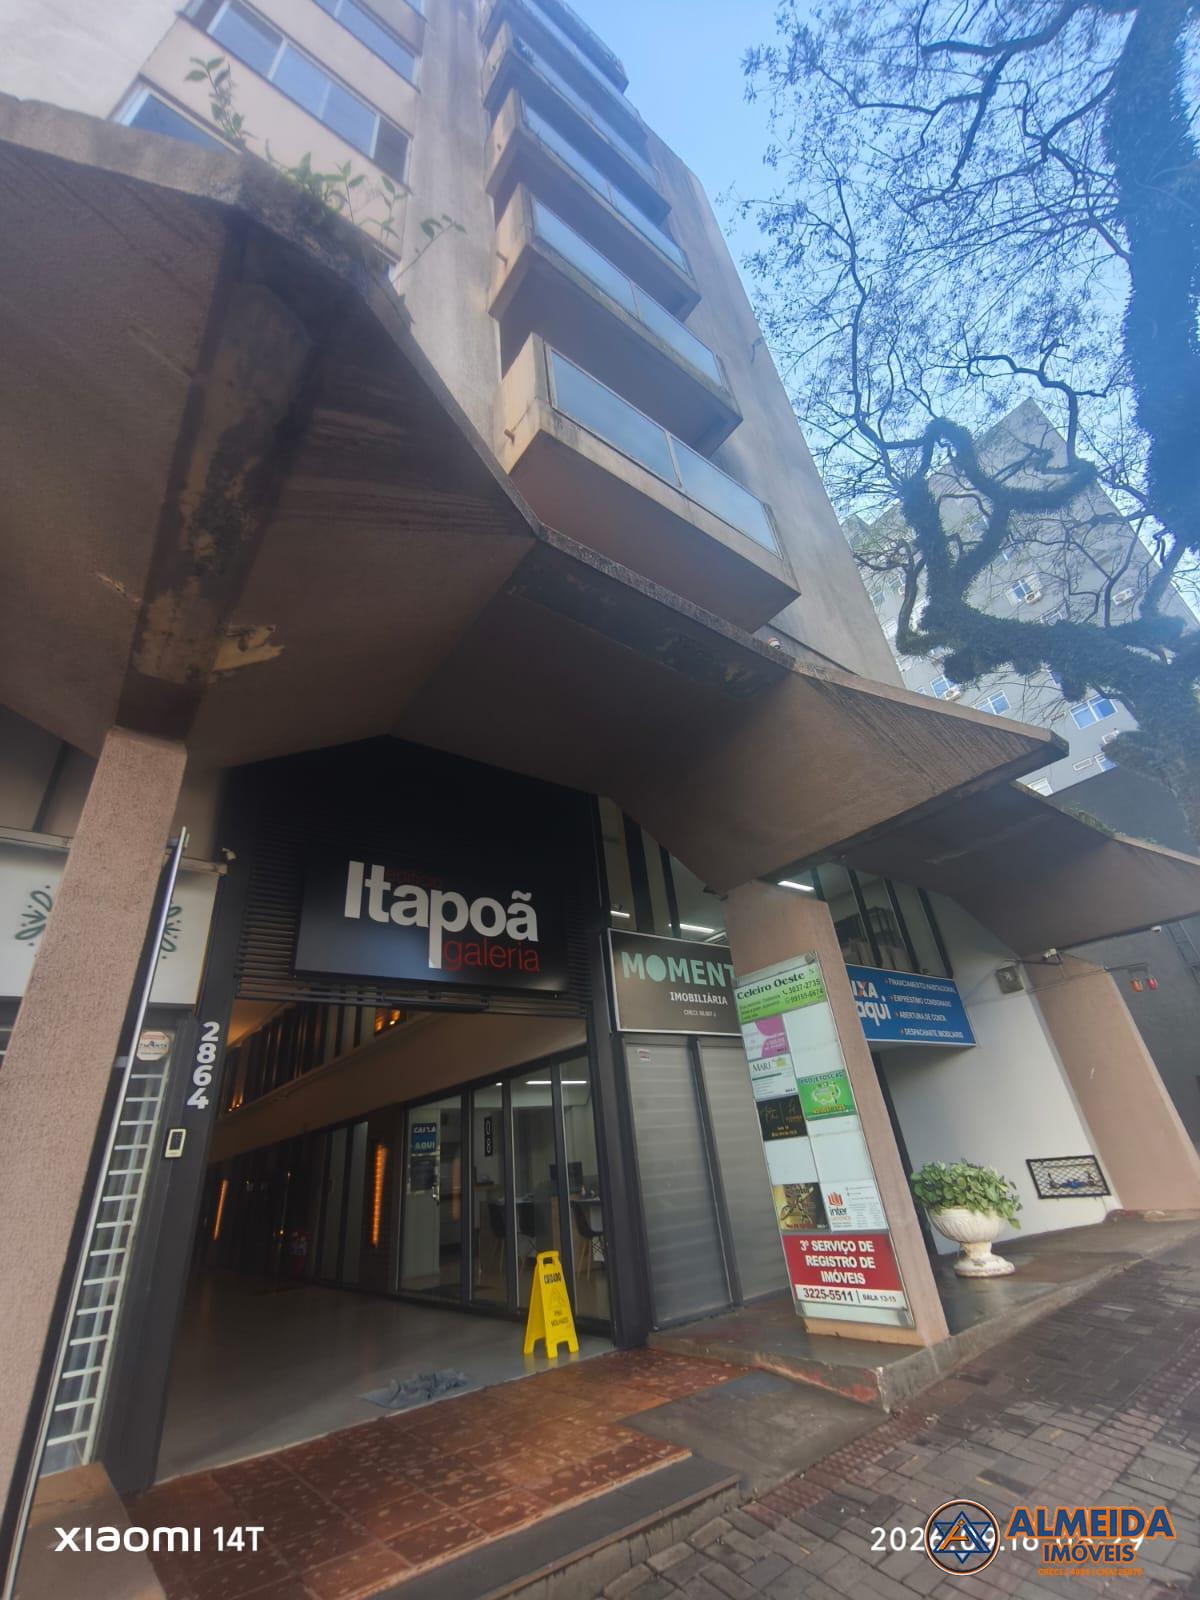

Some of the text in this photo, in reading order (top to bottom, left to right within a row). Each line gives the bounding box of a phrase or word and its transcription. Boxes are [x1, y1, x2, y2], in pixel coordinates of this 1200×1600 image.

[344, 860, 539, 969] Itapoã
[443, 937, 540, 973] galeria
[736, 972, 804, 1000] Celeiro Oeste
[670, 991, 728, 1005] IMOBILIÁRIA
[855, 996, 891, 1027] aqui
[186, 1021, 220, 1109] 2864
[829, 1206, 847, 1216] inter
[812, 1240, 856, 1255] SERVIÇO
[859, 1240, 875, 1252] DE
[805, 1255, 876, 1269] REGISTRO DE
[820, 1269, 866, 1285] IMÓVEIS
[803, 1288, 854, 1302] 3225-5511
